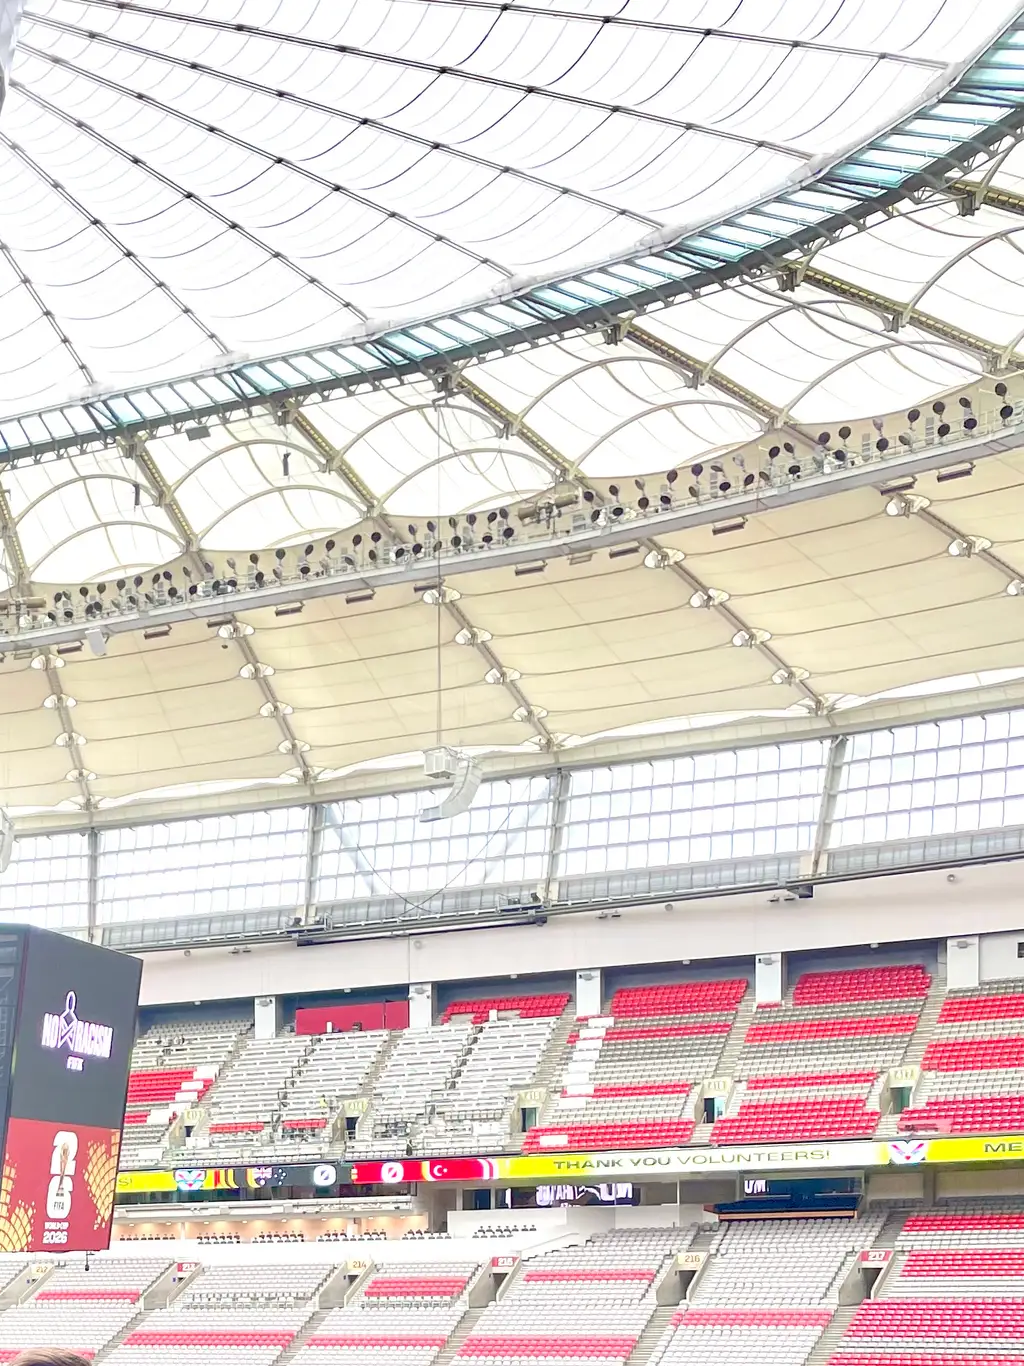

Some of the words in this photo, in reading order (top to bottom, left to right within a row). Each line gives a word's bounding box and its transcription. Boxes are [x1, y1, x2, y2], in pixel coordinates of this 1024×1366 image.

[42, 1012, 60, 1048] NO
[73, 1020, 114, 1058] RACISM
[553, 1158, 624, 1169] THANK
[629, 1157, 671, 1167] YOU
[677, 1150, 830, 1165] VOLUNTEERS!
[53, 1201, 64, 1211] FIFA
[42, 1230, 69, 1244] 2026
[684, 1254, 701, 1262] 216
[352, 1260, 367, 1269] 214
